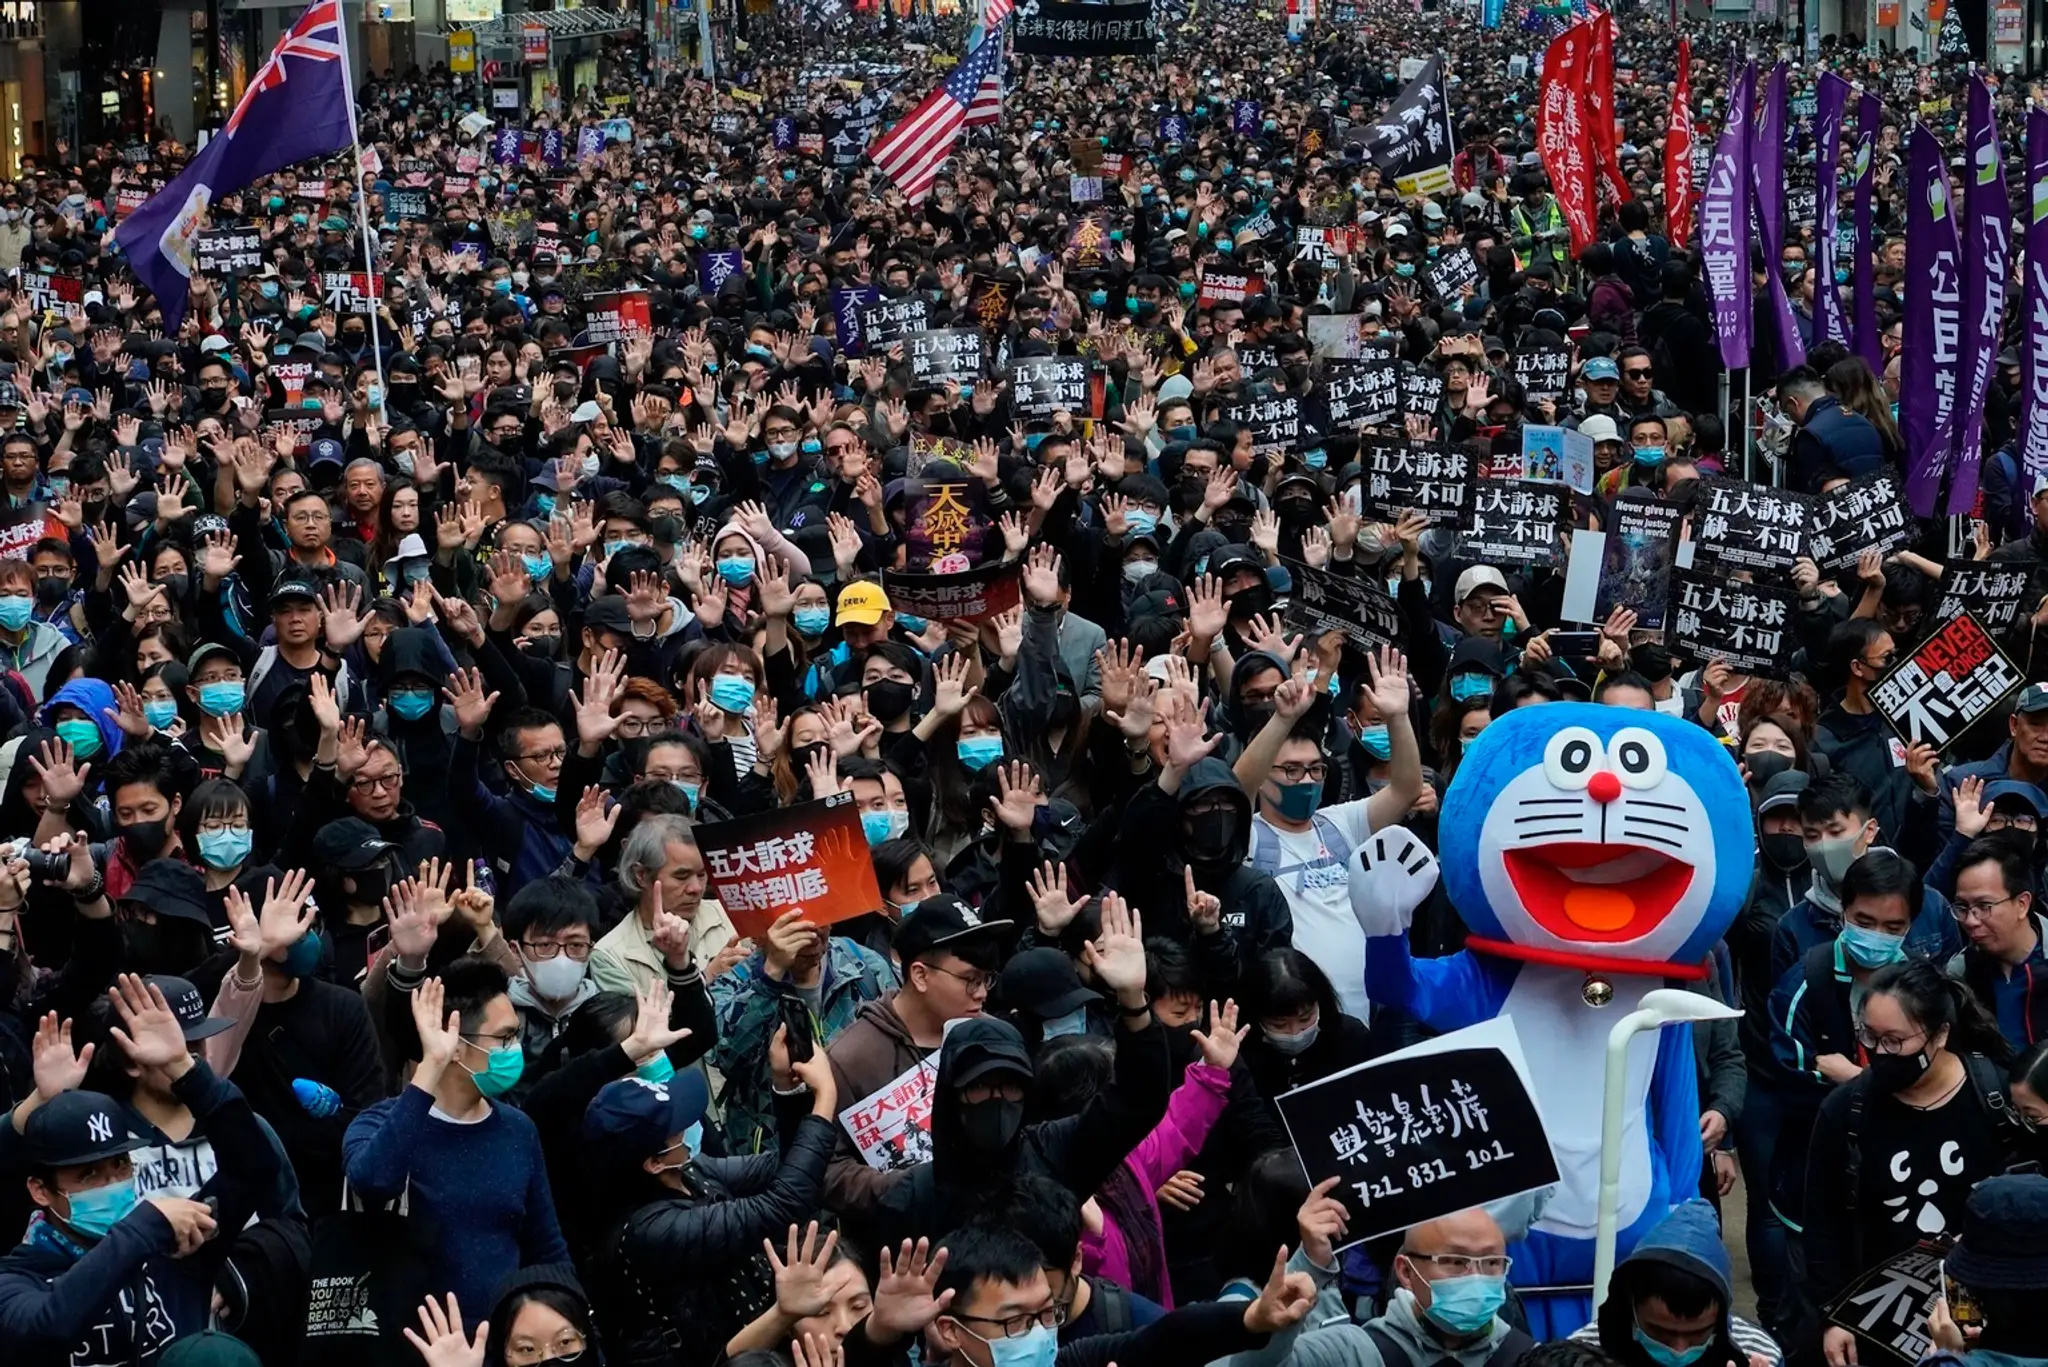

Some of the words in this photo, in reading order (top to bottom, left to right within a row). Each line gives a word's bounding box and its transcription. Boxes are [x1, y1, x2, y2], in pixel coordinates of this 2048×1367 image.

[200, 236, 260, 251] 五大訴求
[325, 273, 351, 287] 我們
[1203, 274, 1247, 287] 五大訴求
[1428, 246, 1473, 283] 五大訴求
[1435, 259, 1478, 297] 缺一不可
[863, 301, 927, 326] 五大訴求
[912, 334, 980, 357] 五大訴求
[912, 352, 981, 376] 缺一不可
[1013, 362, 1085, 384] 五大訴求
[1514, 354, 1568, 372] 五大訴求
[1014, 382, 1085, 403] 缺一不可
[1327, 367, 1397, 400] 五大訴求
[1330, 389, 1398, 421] 缺一不可
[1405, 395, 1440, 414] 不可
[1371, 446, 1469, 480] 五大訴求
[1369, 473, 1467, 508] 缺一不可
[1615, 500, 1643, 513] Never
[1644, 505, 1664, 517] give
[1621, 515, 1643, 527] Show
[1707, 487, 1805, 527] 五大訴求
[1619, 524, 1628, 533] to
[1701, 513, 1802, 556] 缺一不可
[1808, 501, 1904, 561] 缺一不可
[1949, 571, 2028, 597] 五大訴求
[1679, 580, 1788, 627] 五大訴求
[1676, 610, 1784, 656] 缺一不可
[1915, 614, 1983, 678] NEVER
[1945, 636, 1995, 682] FORGET
[1874, 659, 1929, 716] 我們
[1892, 652, 2020, 745] 不忘記
[706, 831, 815, 878] 五大訴求
[718, 868, 829, 911] 堅持到底
[847, 1068, 937, 1134] 五大訴求
[86, 1111, 114, 1142] NY
[1352, 1175, 1403, 1207] 721
[1407, 1158, 1456, 1189] 831
[1465, 1140, 1514, 1170] 101
[311, 1288, 333, 1301] YOU
[312, 1278, 329, 1288] THE
[330, 1276, 355, 1287] BOOK
[308, 1309, 336, 1323] READ
